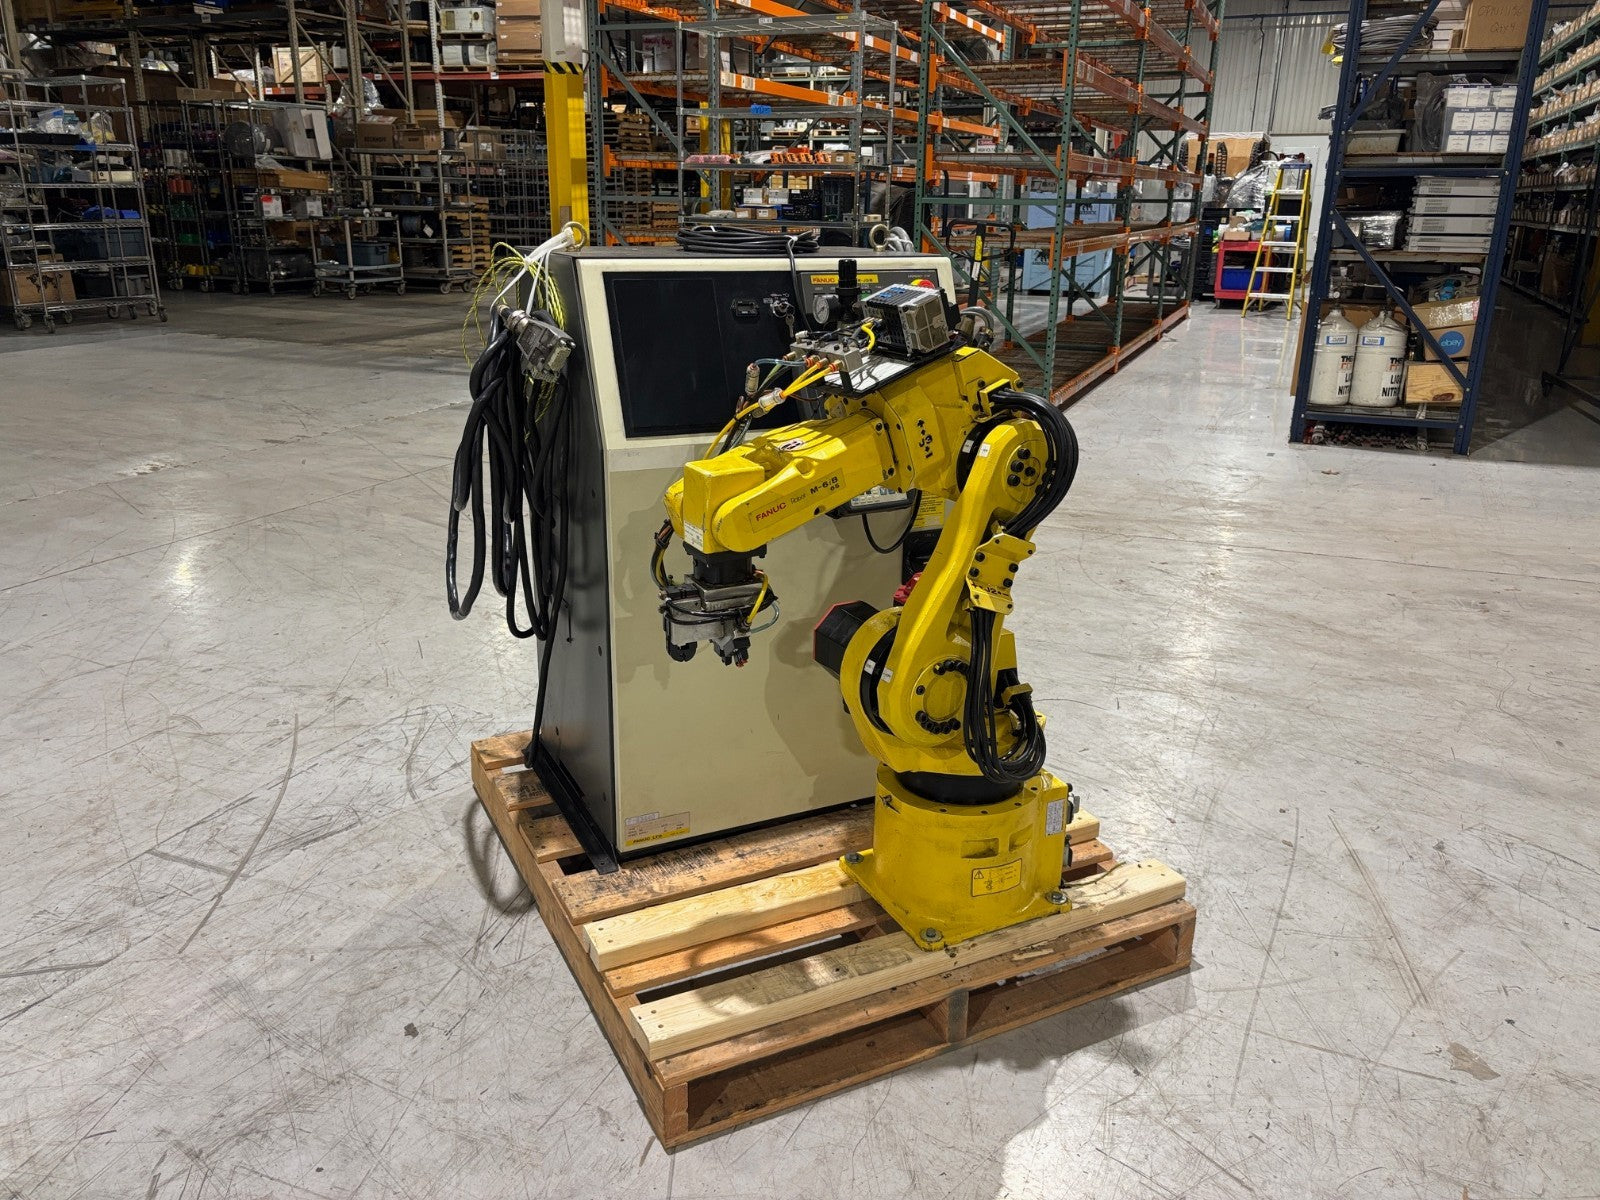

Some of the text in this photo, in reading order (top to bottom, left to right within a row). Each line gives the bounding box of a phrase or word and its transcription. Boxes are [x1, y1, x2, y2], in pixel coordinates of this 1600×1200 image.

[1440, 339, 1463, 347] ebay
[755, 502, 787, 522] FANUC
[790, 493, 807, 504] Robot
